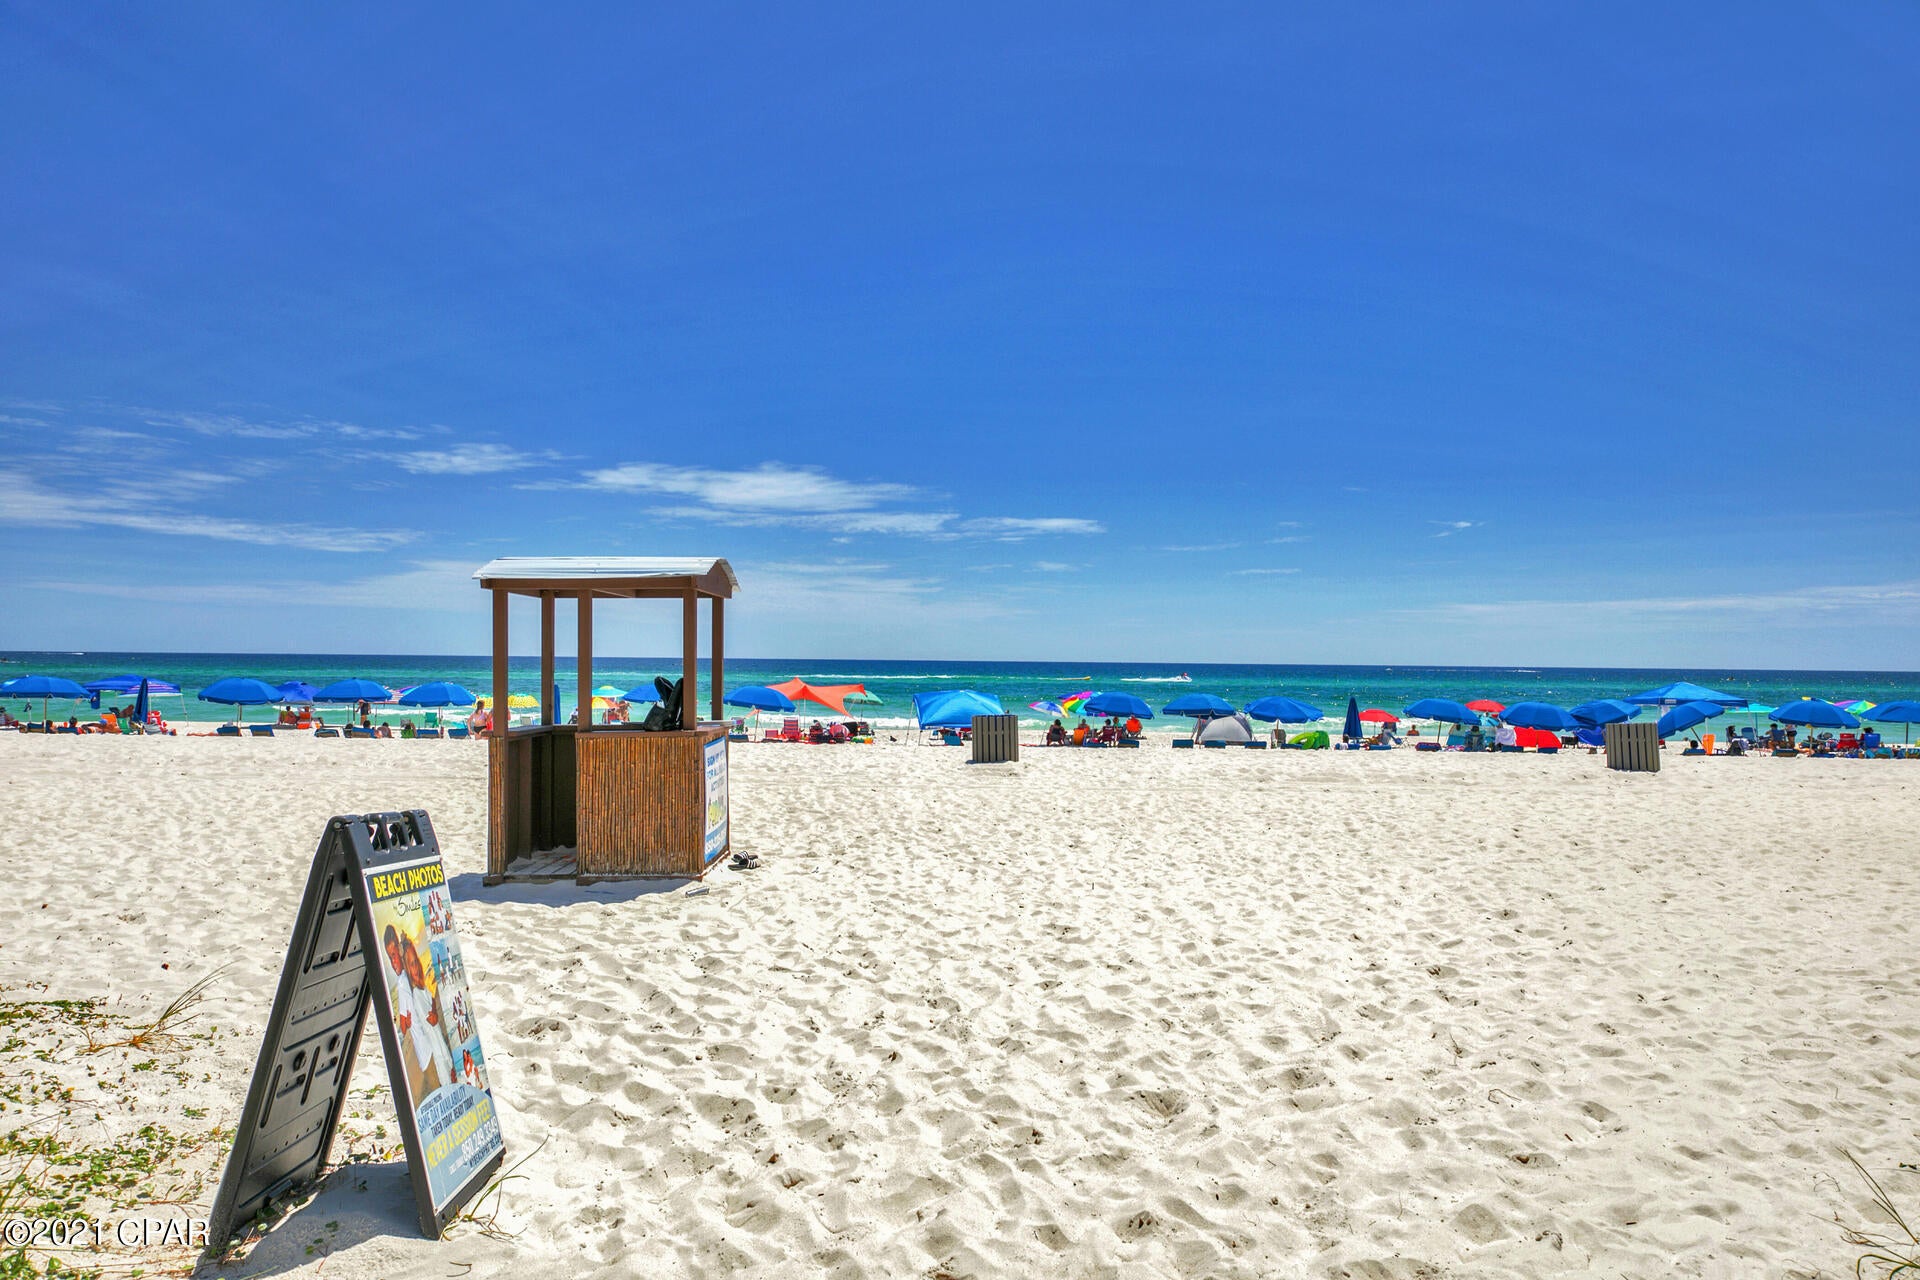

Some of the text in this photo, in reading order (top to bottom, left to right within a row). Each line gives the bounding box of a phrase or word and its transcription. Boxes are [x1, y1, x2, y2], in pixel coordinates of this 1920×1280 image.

[373, 864, 444, 899] BEACH PHOTOS
[417, 1085, 466, 1134] SAME DAY AVAILABILITY
[430, 1120, 443, 1138] TAKEN
[426, 1134, 449, 1170] NEVER
[447, 1129, 455, 1149] A
